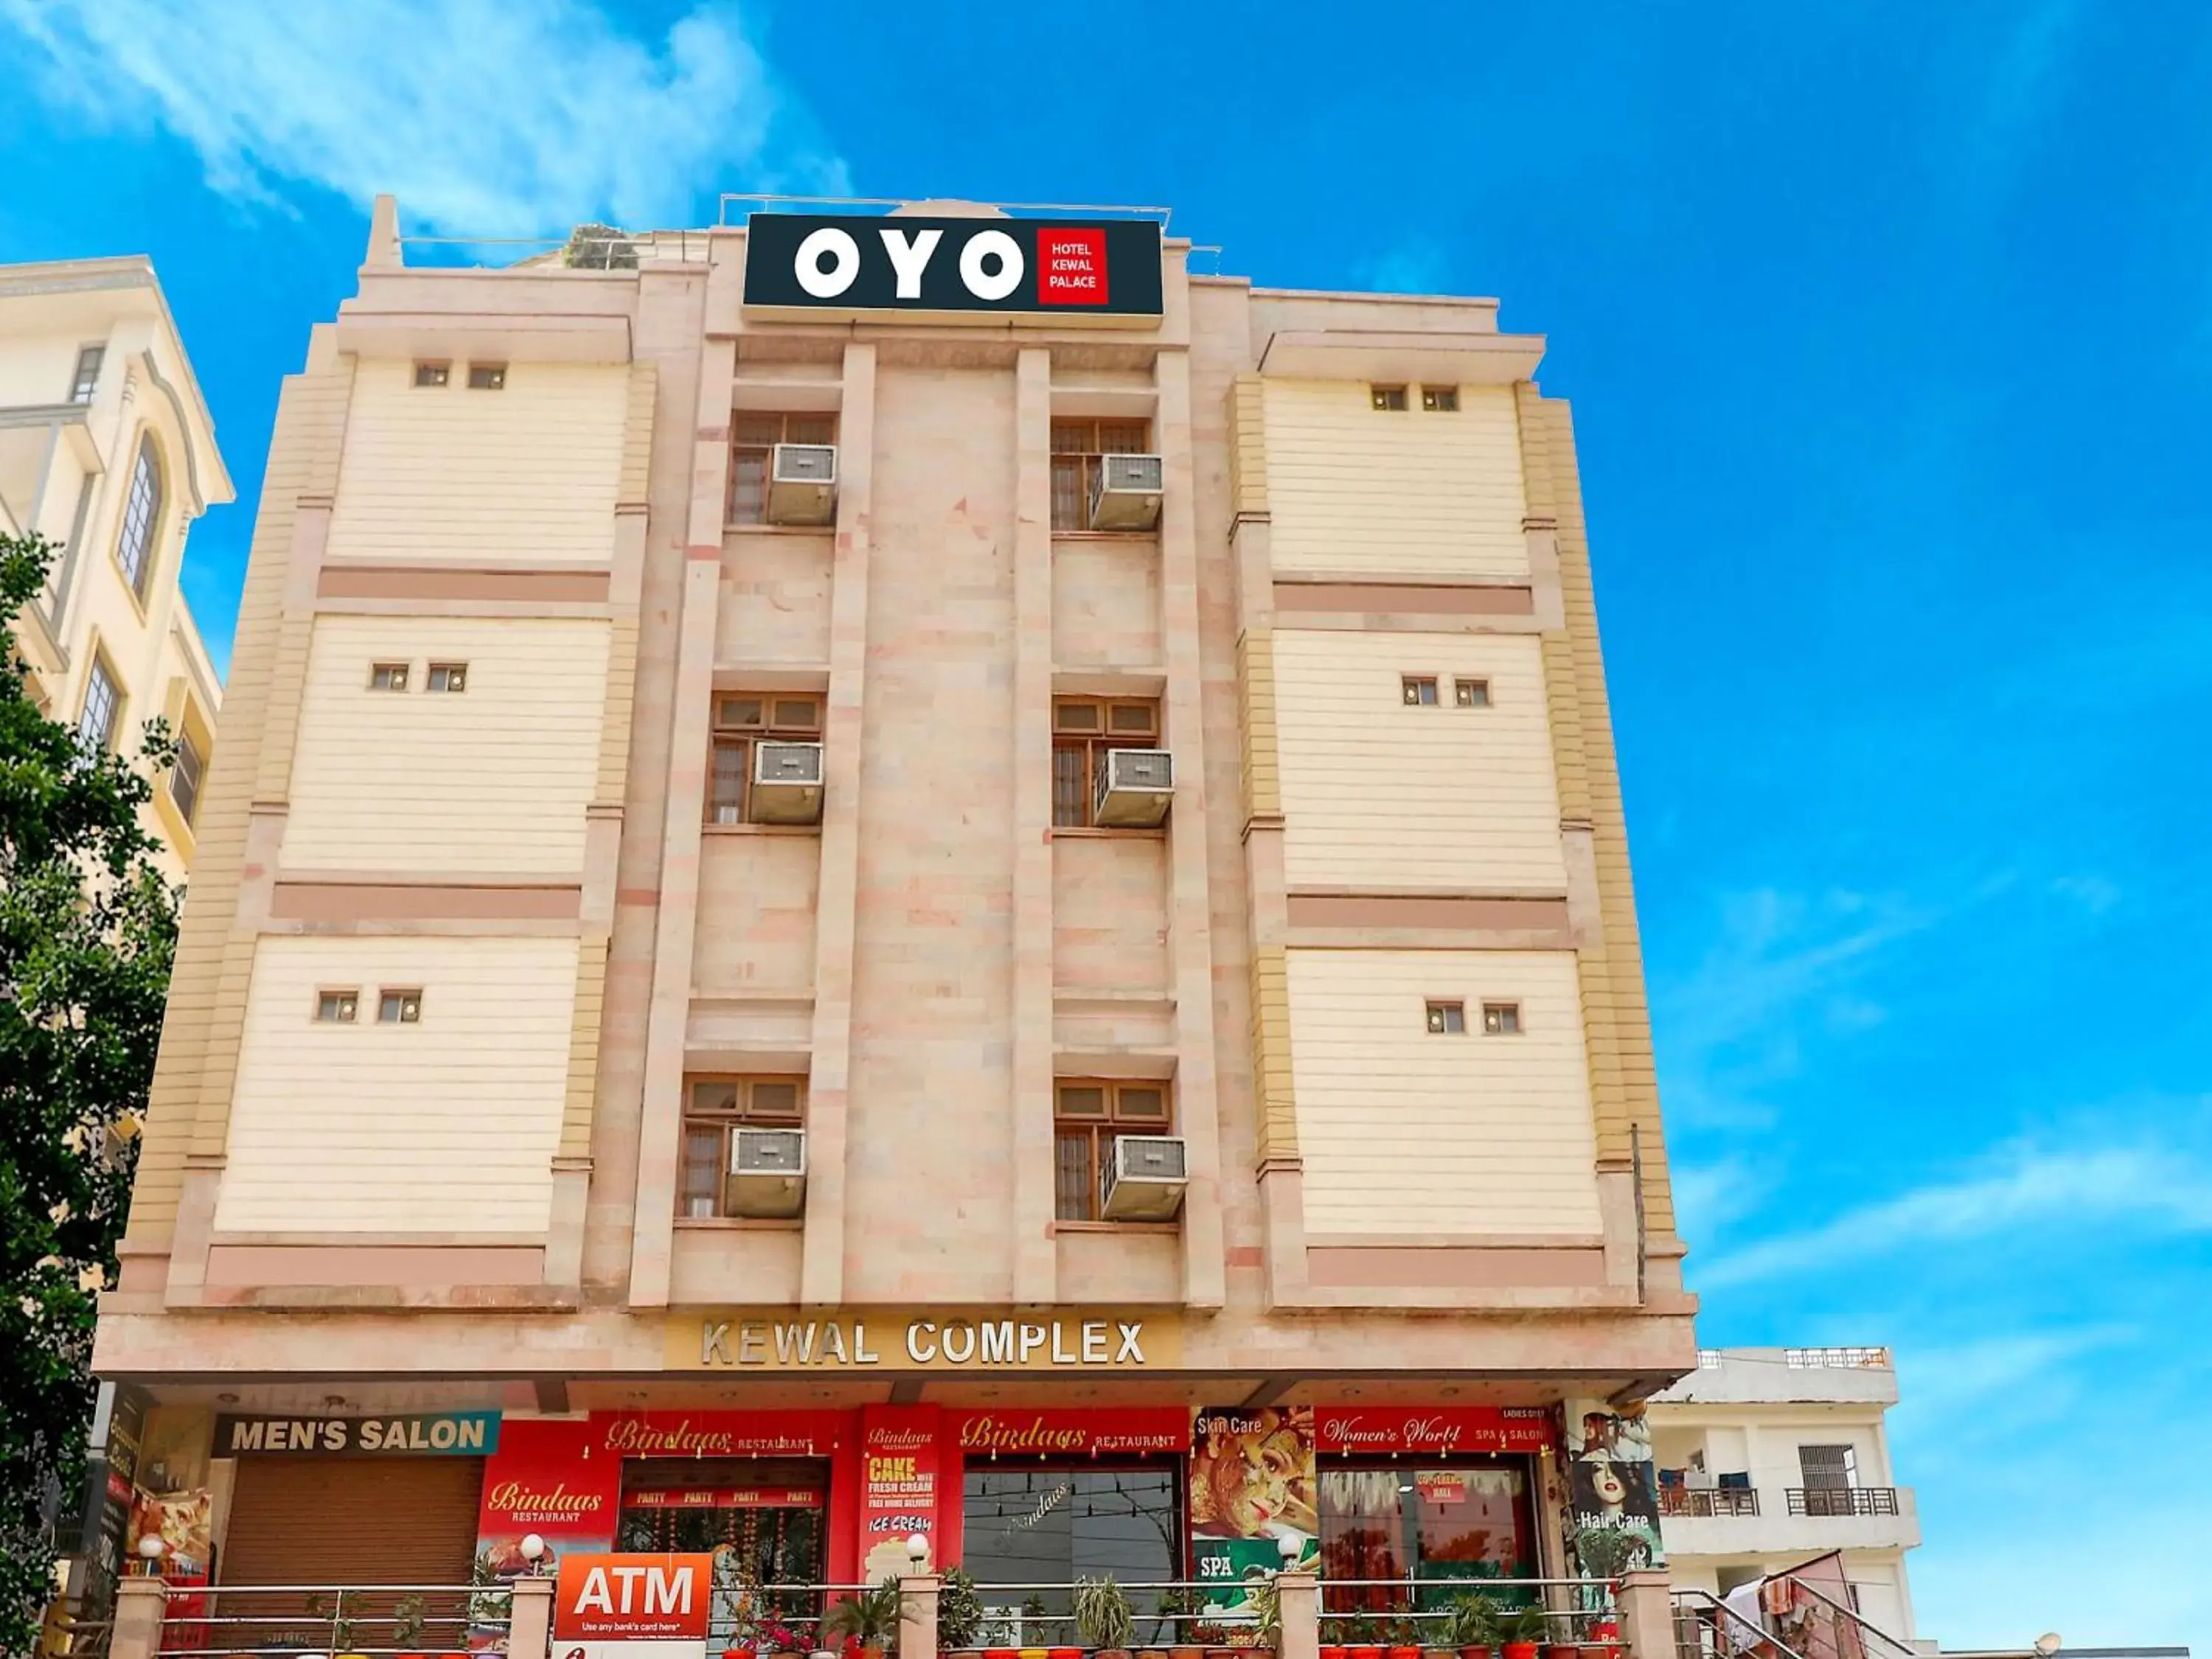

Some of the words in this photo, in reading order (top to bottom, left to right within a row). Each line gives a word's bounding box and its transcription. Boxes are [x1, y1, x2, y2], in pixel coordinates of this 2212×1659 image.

[1051, 243, 1092, 255] HOTEL
[794, 227, 1024, 301] OYO
[1051, 260, 1093, 272] KEWAL
[1049, 276, 1096, 290] PALACE
[700, 1320, 880, 1365] KEWAL
[906, 1320, 1145, 1364] COMPLEX
[231, 1419, 347, 1451] MEN'S
[358, 1419, 485, 1450] SALON
[604, 1420, 732, 1450] Bindaas
[738, 1438, 813, 1450] RESTAURANT
[960, 1416, 1087, 1448] Bindaas
[1095, 1435, 1177, 1447] RESTAURANT
[1197, 1416, 1228, 1435] Skin
[1231, 1416, 1262, 1434] Care
[1324, 1416, 1398, 1442] Women's
[1403, 1416, 1462, 1442] World
[1475, 1430, 1496, 1440] SPA
[1509, 1430, 1544, 1440] SALON
[868, 1427, 933, 1444] Bindaas
[869, 1456, 916, 1483] CAKE
[487, 1481, 602, 1512] Bindaas
[869, 1483, 898, 1492] FRESH
[900, 1483, 933, 1492] CREAM
[637, 1492, 667, 1503] PARTY
[684, 1492, 714, 1503] PARTY
[733, 1492, 759, 1503] PARTY
[787, 1492, 813, 1503] PARTY
[512, 1512, 580, 1523] RESTAURANT
[869, 1517, 889, 1531] ICE
[891, 1515, 932, 1532] CREAM
[1580, 1512, 1610, 1528] Hair
[1615, 1511, 1649, 1528] Care
[1200, 1557, 1234, 1577] SPA
[573, 1567, 694, 1614] ATM
[582, 1623, 598, 1631] Use
[599, 1624, 613, 1632] any
[614, 1623, 639, 1631] bank's
[640, 1623, 658, 1631] card
